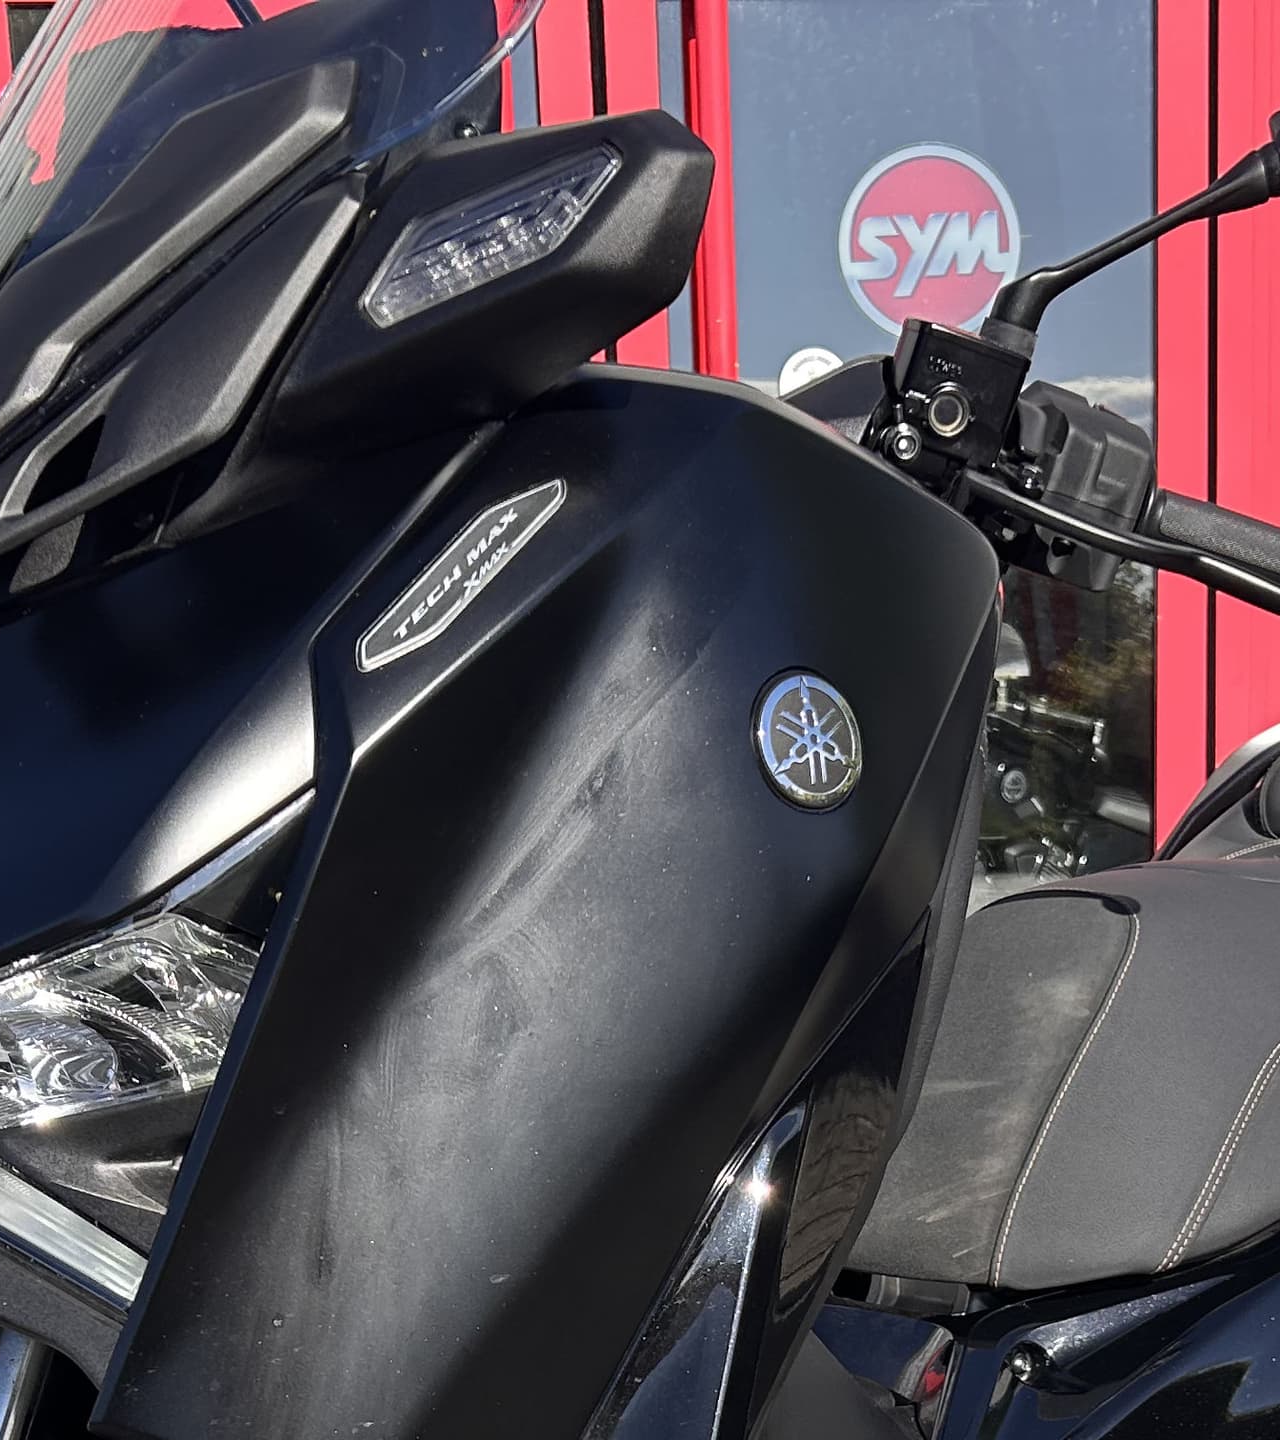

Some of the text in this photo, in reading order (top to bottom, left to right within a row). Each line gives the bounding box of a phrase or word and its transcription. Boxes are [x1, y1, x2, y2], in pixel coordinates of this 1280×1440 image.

[850, 209, 1011, 297] SYM
[393, 508, 518, 639] TECH MAX
[463, 541, 509, 598] XMAX
